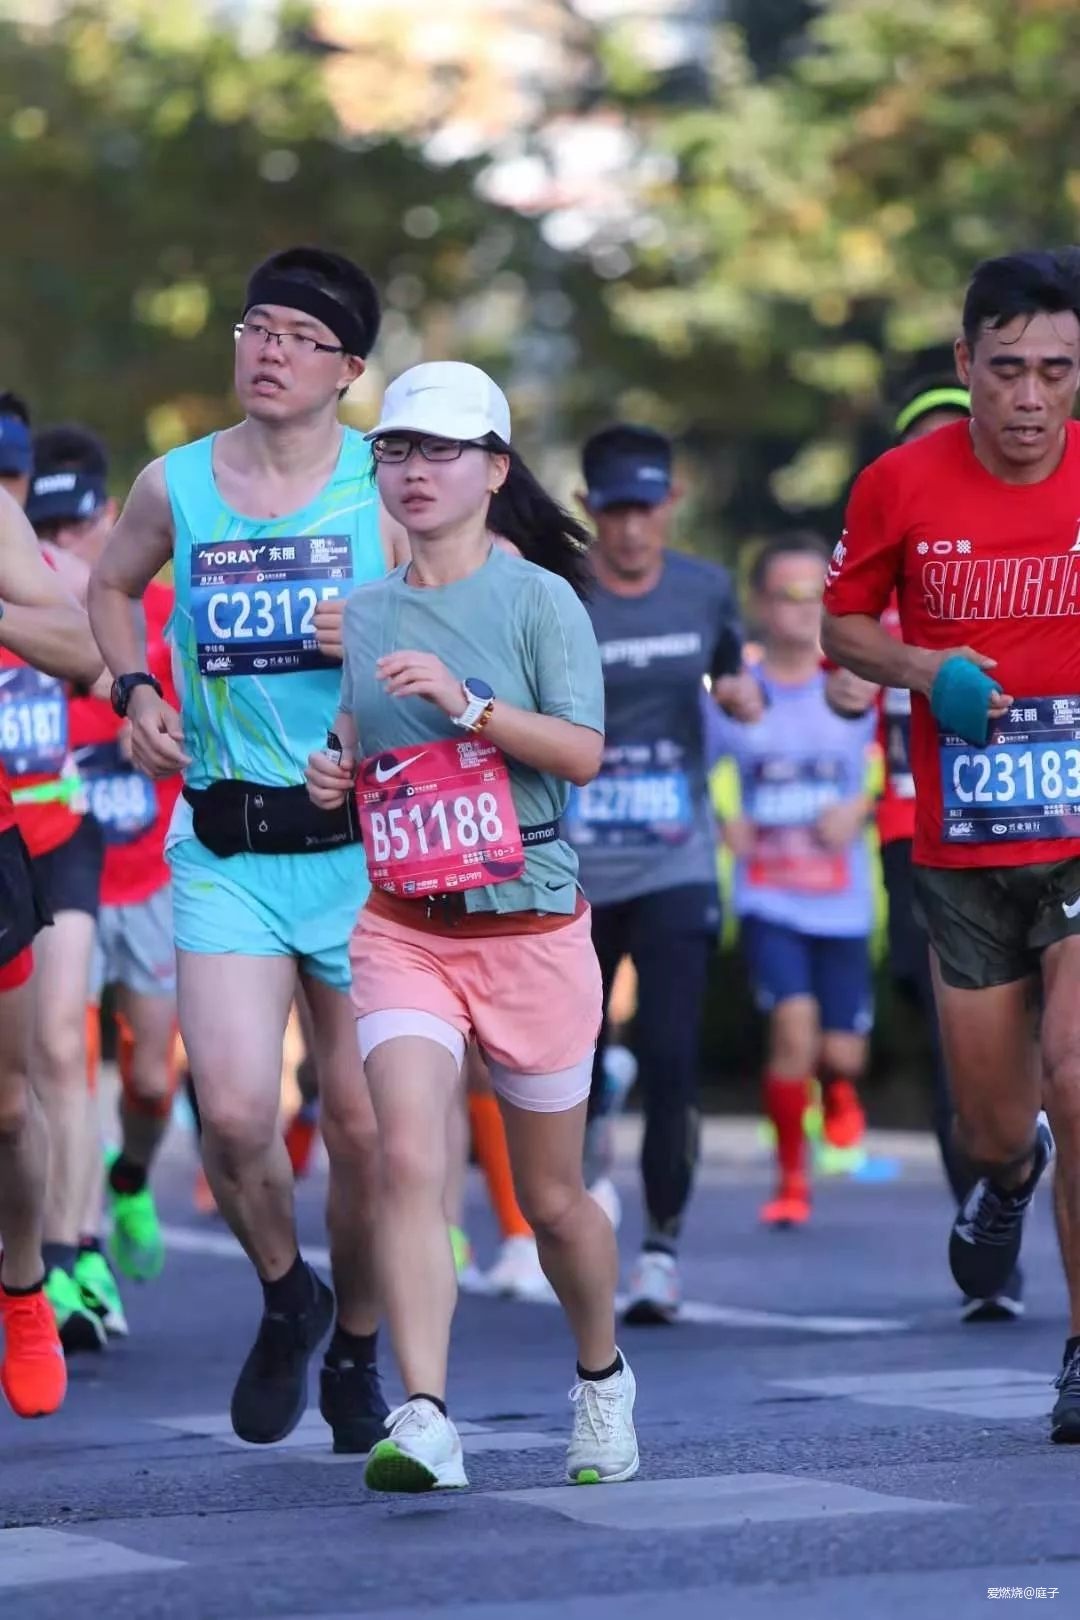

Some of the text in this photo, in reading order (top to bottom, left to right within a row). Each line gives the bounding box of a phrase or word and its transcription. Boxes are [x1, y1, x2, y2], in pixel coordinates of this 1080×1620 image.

[269, 546, 296, 561] 东丽
[1010, 709, 1038, 722] 东丽
[953, 748, 1080, 803] C23183
[370, 791, 503, 862] B51188
